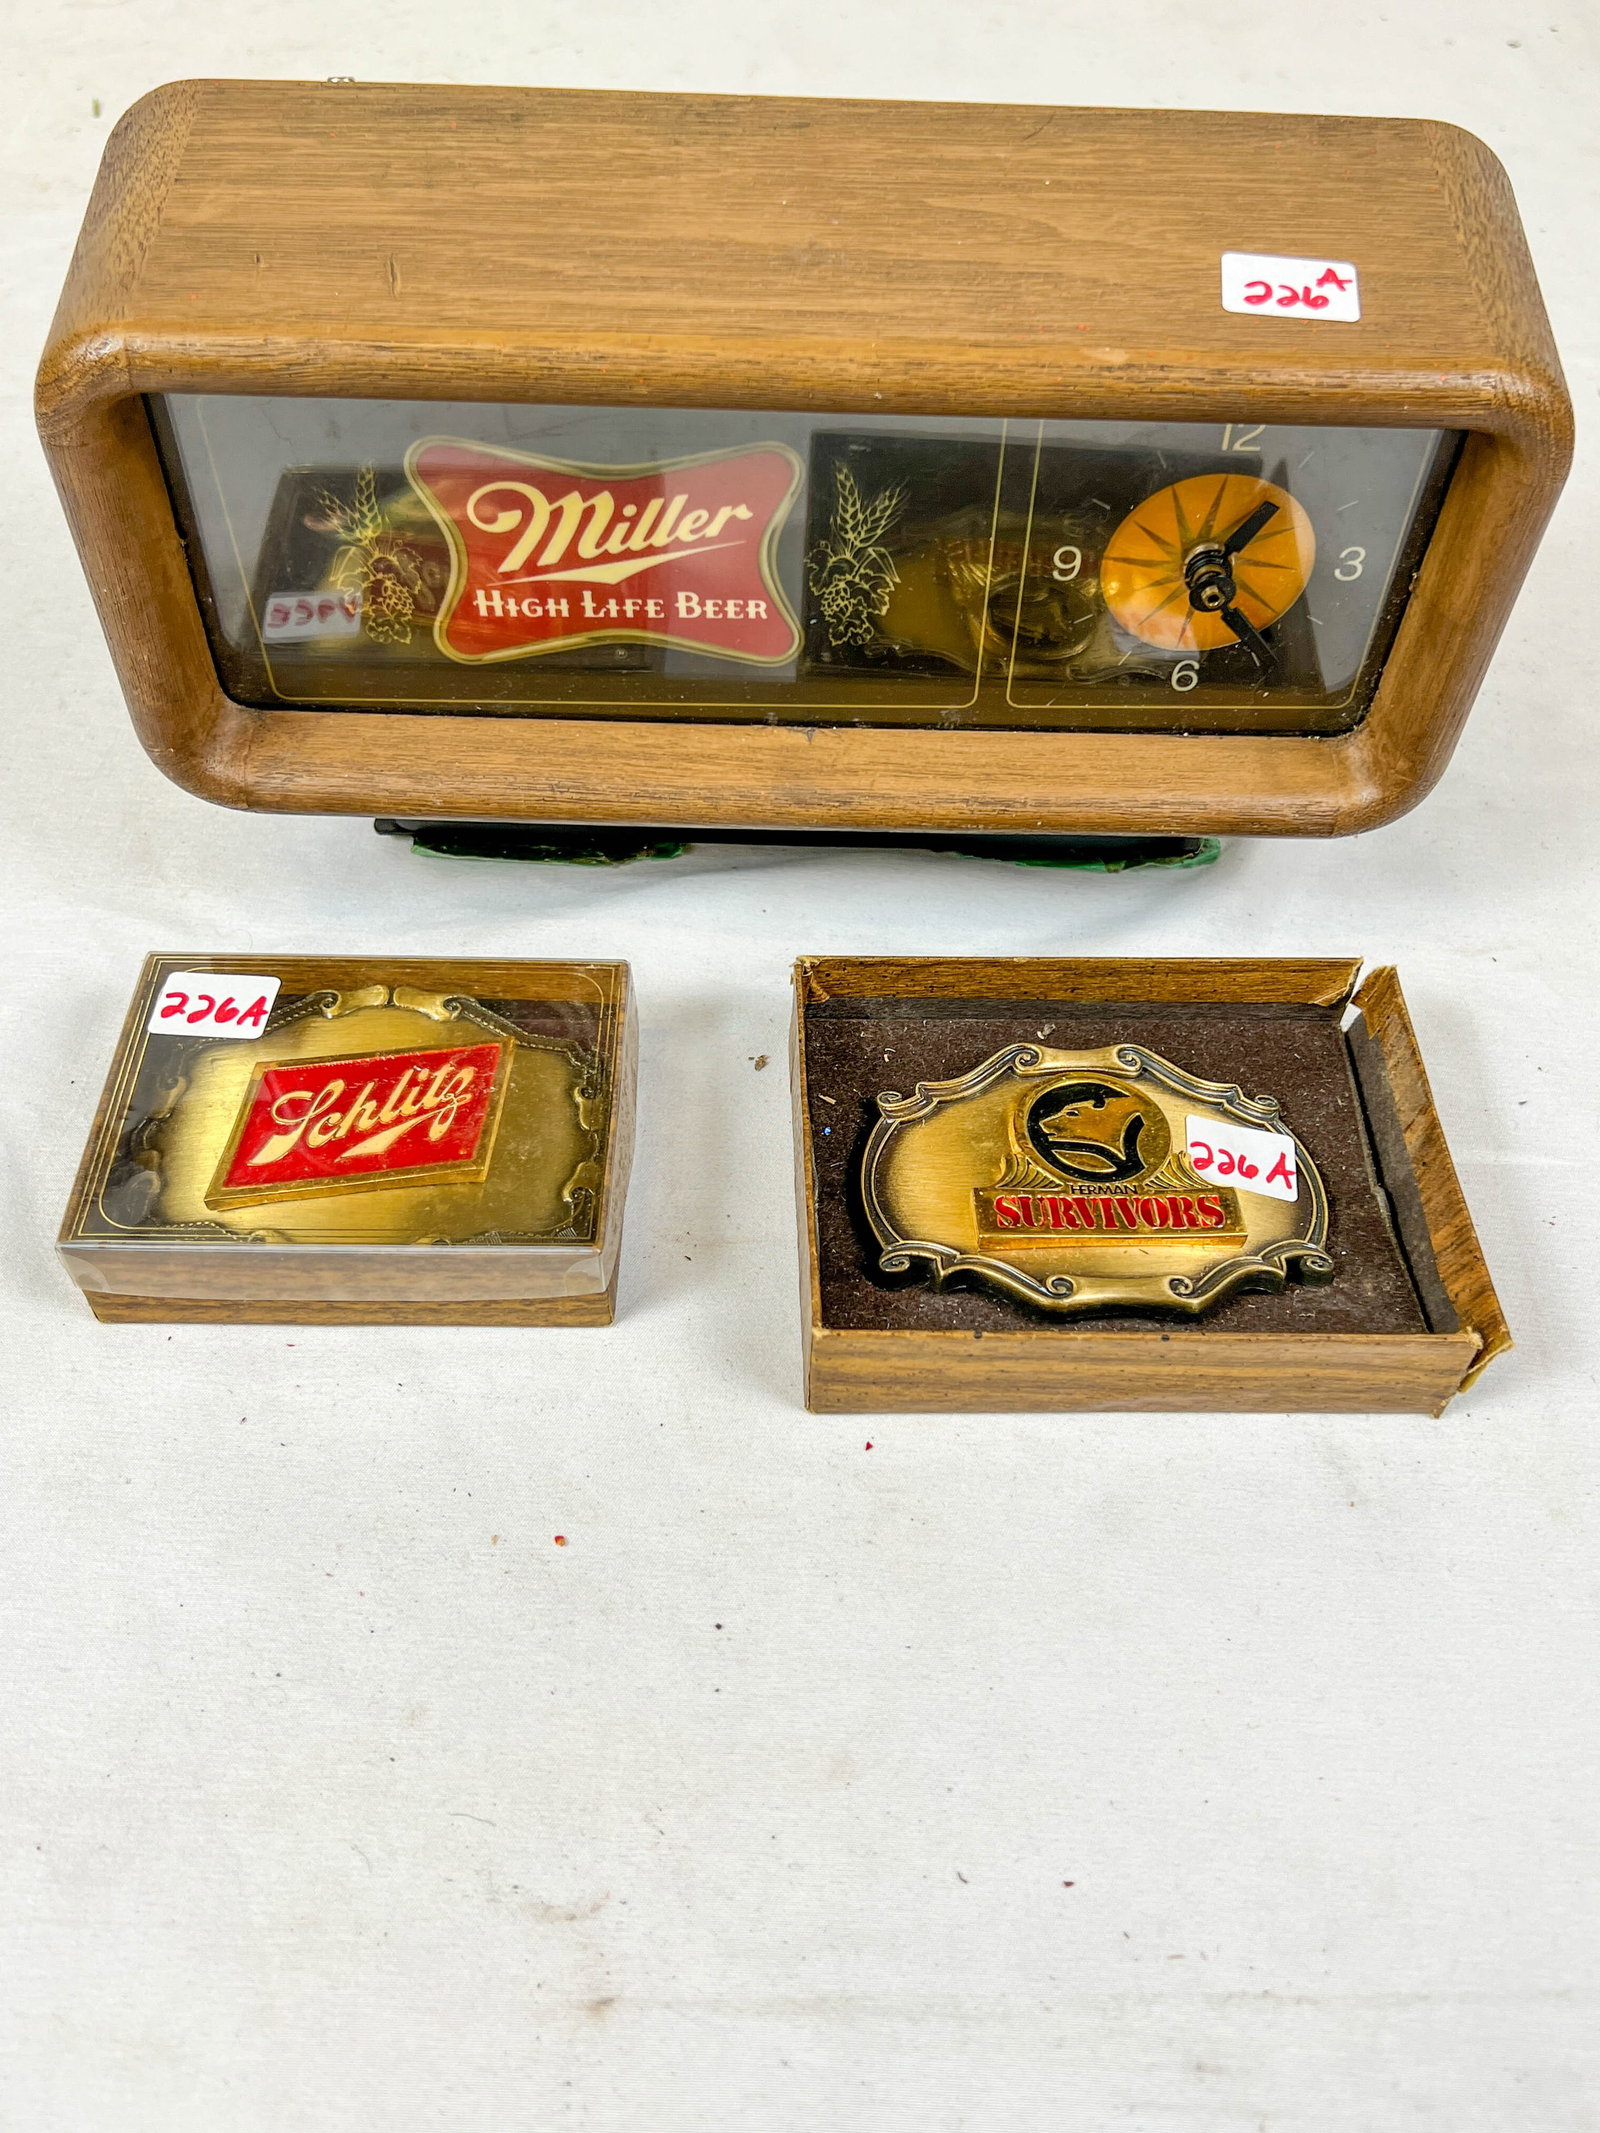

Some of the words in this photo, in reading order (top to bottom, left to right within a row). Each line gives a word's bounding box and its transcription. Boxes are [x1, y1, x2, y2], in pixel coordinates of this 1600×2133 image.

[1221, 423, 1267, 452] 12
[467, 481, 754, 573] Miller
[1052, 546, 1082, 582] 9
[1333, 546, 1365, 582] 3
[473, 589, 570, 618] HIGH
[580, 590, 666, 619] LIFE
[675, 591, 769, 620] BEER
[1170, 659, 1201, 692] 6
[160, 991, 269, 1028] 226A
[246, 1063, 478, 1167] Schlitz
[1070, 1184, 1139, 1195] HERMAN
[992, 1194, 1227, 1231] SURVIVORS
